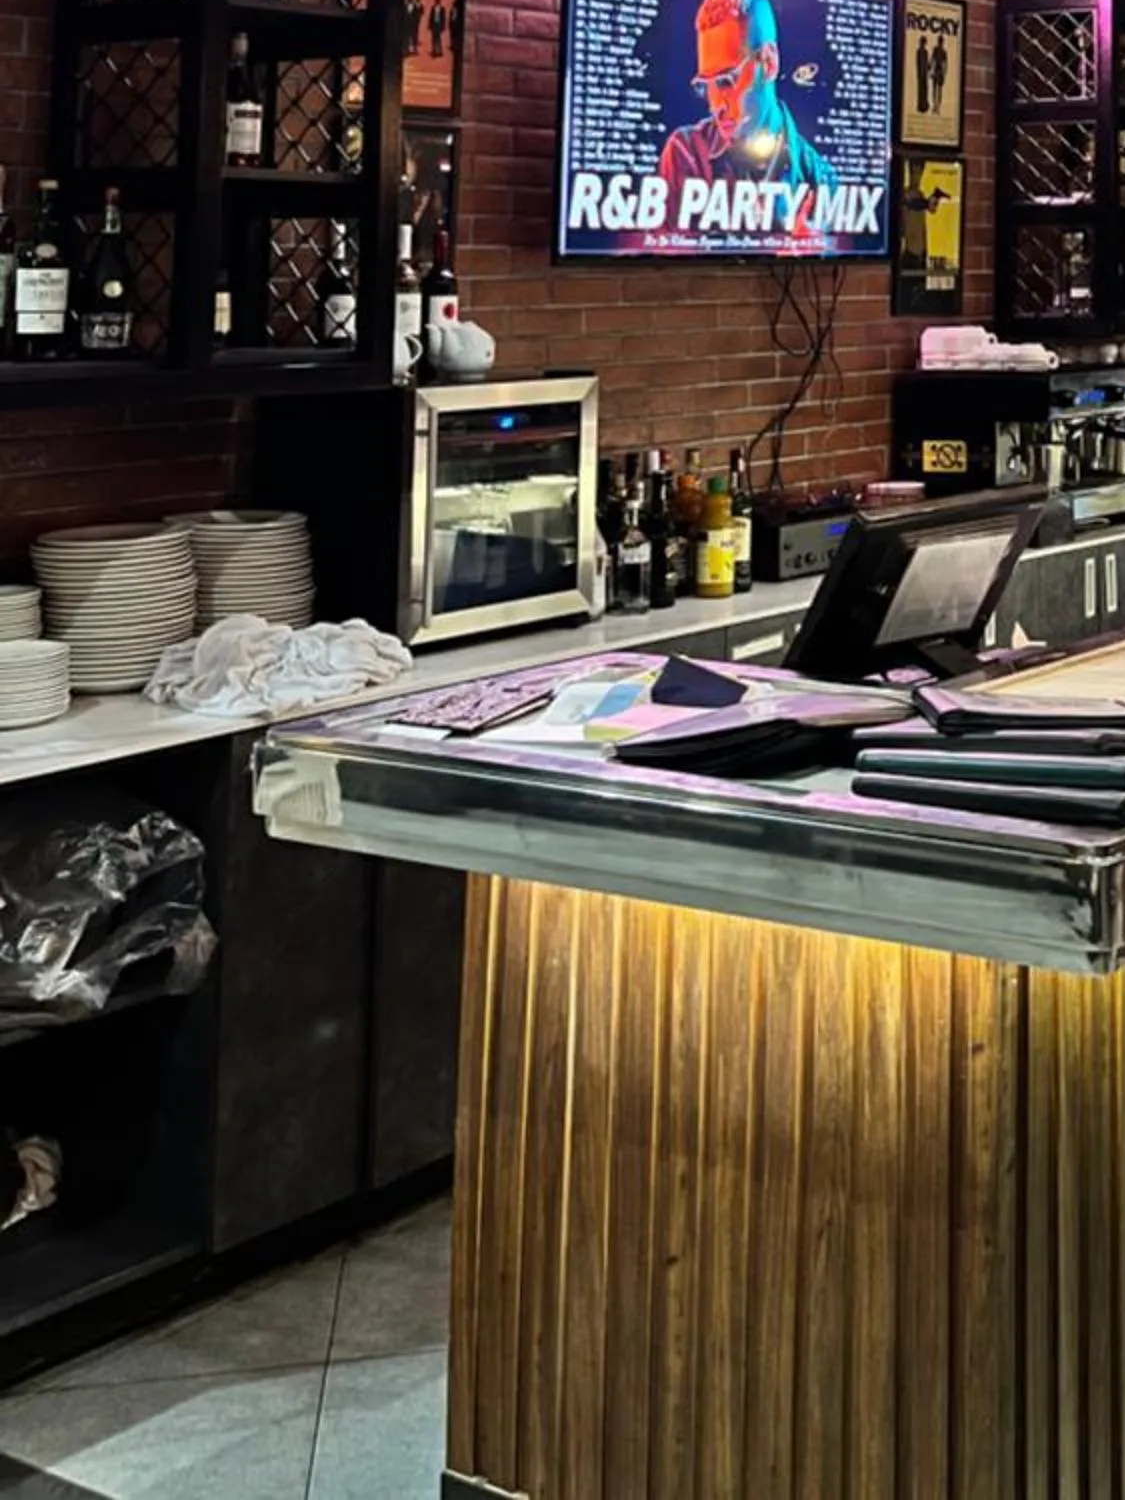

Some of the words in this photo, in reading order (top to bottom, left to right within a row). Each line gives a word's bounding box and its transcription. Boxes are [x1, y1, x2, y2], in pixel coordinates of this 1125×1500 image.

[907, 11, 960, 37] ROCKY
[568, 173, 668, 230] R&B
[677, 178, 808, 233] PARTY
[811, 184, 884, 234] MIX
